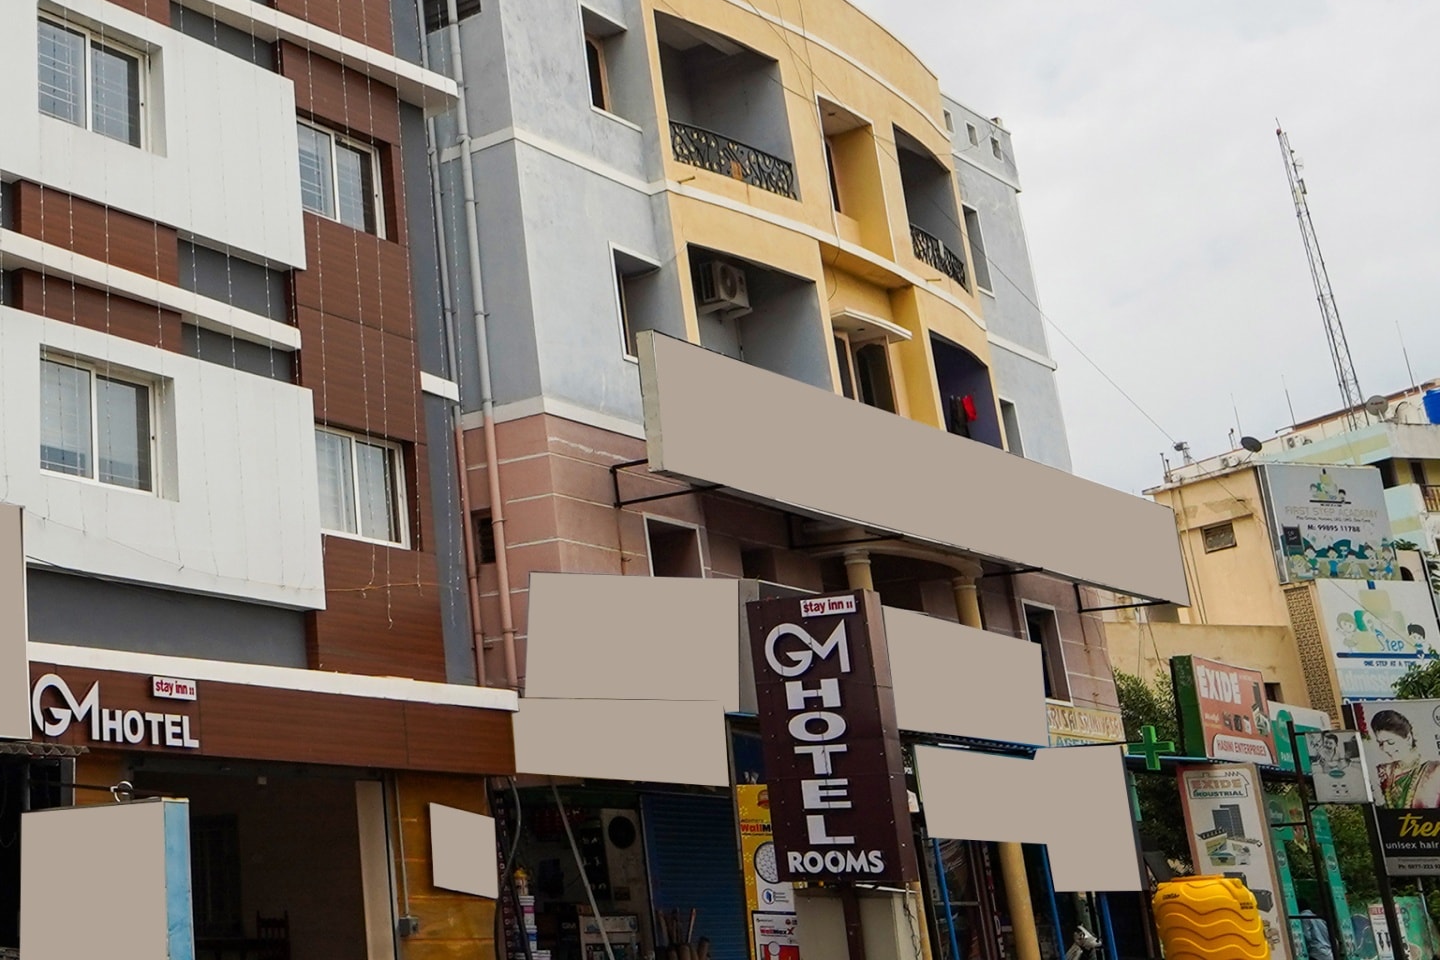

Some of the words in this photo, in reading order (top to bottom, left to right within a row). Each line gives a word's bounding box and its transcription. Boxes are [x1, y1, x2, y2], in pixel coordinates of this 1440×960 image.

[803, 601, 825, 614] stay
[827, 599, 844, 611] inn
[156, 680, 173, 696] stay
[175, 680, 187, 695] inn
[1196, 664, 1242, 705] EXIDE
[102, 708, 200, 748] HOTEL
[785, 678, 855, 845] HOTEL
[1191, 779, 1242, 789] EXIDE
[1193, 789, 1243, 797] INDUSTRIAL
[741, 824, 771, 832] WallM
[1385, 841, 1417, 849] unisex
[1420, 840, 1439, 849] hair
[787, 850, 885, 874] ROOMS
